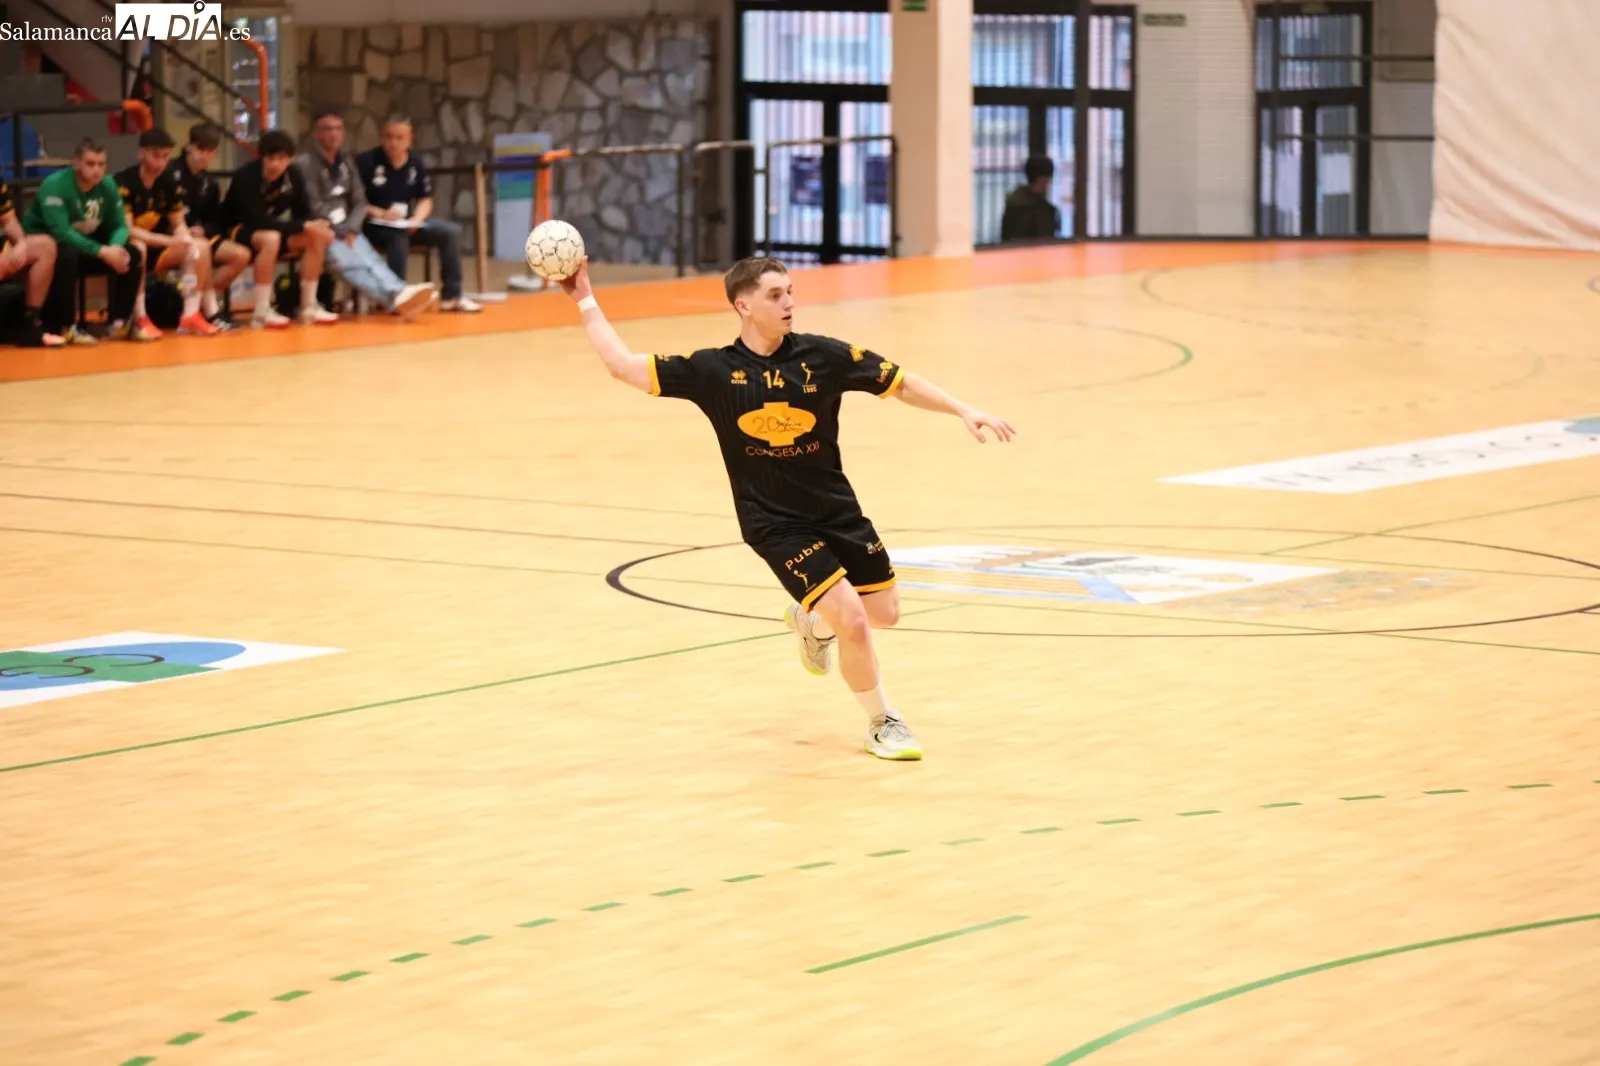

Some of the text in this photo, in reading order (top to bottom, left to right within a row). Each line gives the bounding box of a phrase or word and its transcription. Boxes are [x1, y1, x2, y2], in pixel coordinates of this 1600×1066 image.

[763, 369, 785, 389] 14
[745, 445, 803, 457] CONGESA
[785, 540, 826, 570] Pubee
